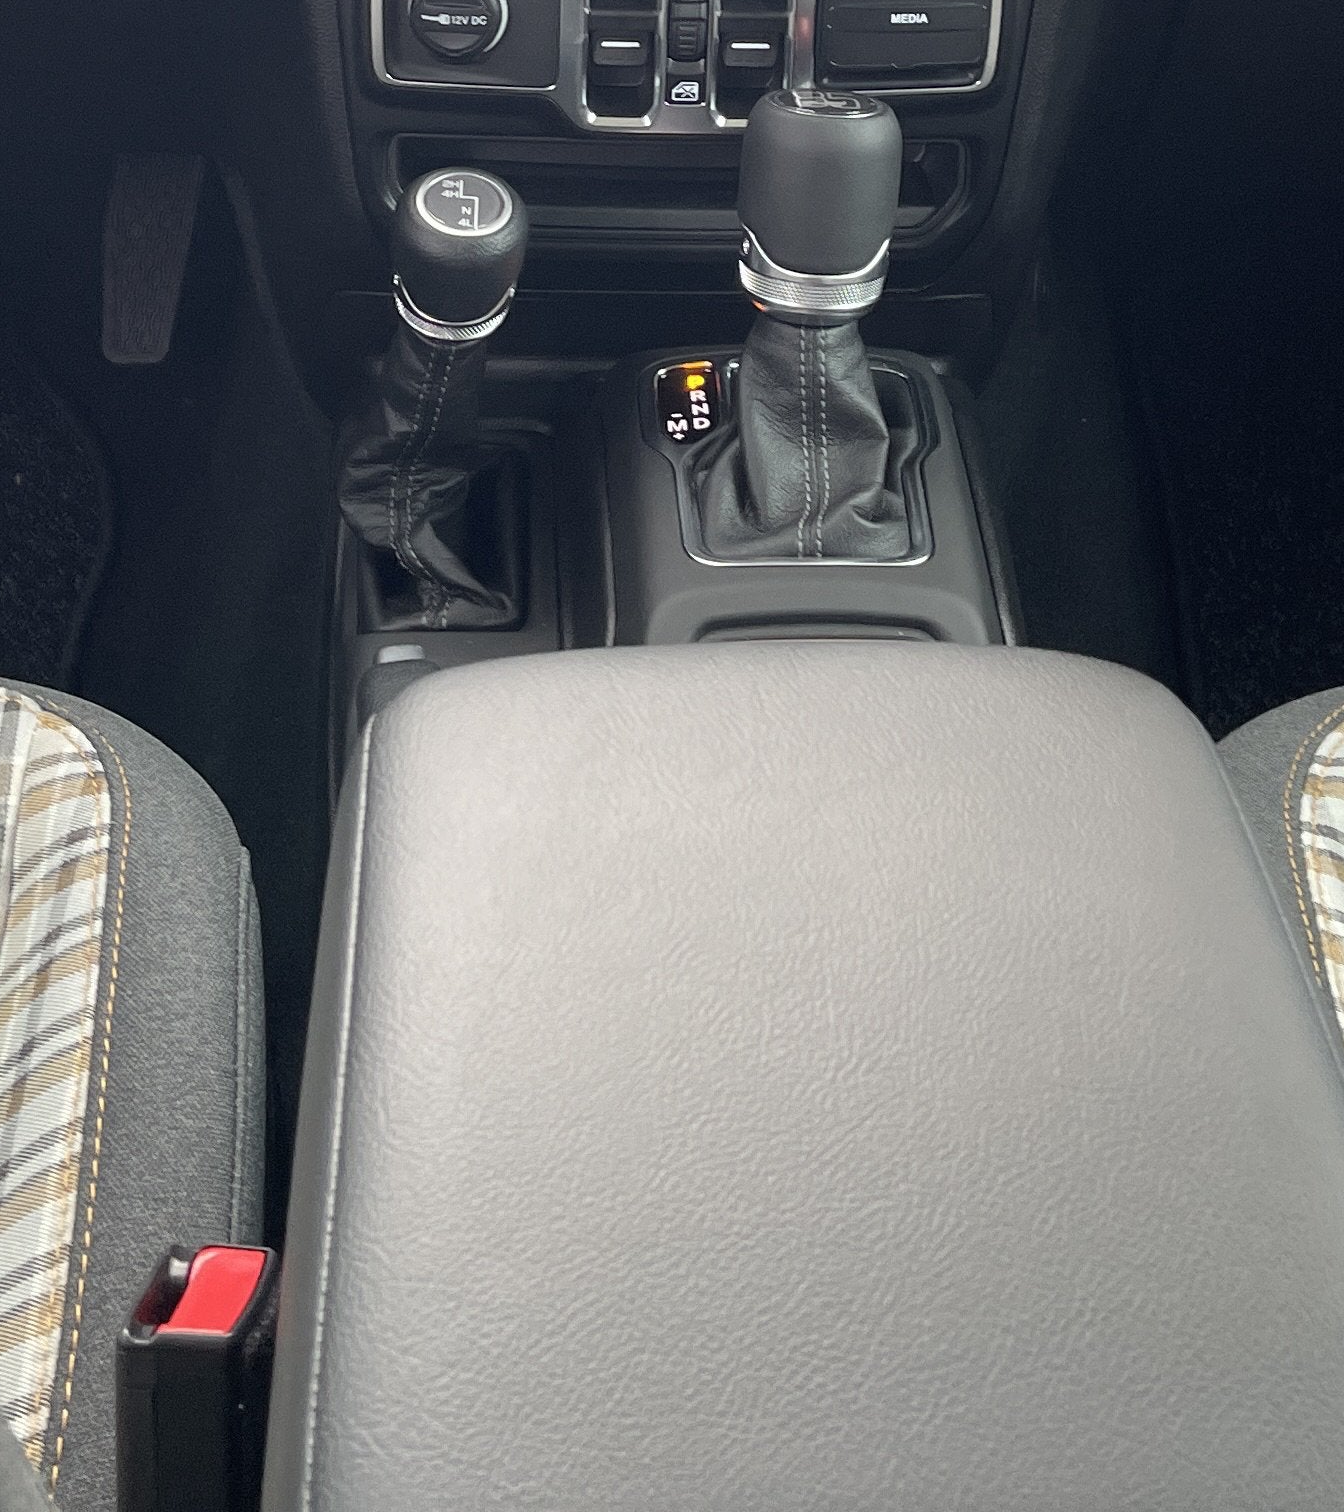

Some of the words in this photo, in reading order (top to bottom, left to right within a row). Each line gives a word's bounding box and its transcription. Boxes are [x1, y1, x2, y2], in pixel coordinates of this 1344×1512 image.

[451, 14, 470, 27] 12V
[471, 15, 488, 27] DC
[889, 12, 929, 25] MEDIA
[686, 374, 705, 390] P
[689, 390, 707, 402] R
[691, 402, 710, 416] N
[666, 418, 688, 433] M
[692, 417, 711, 430] D
